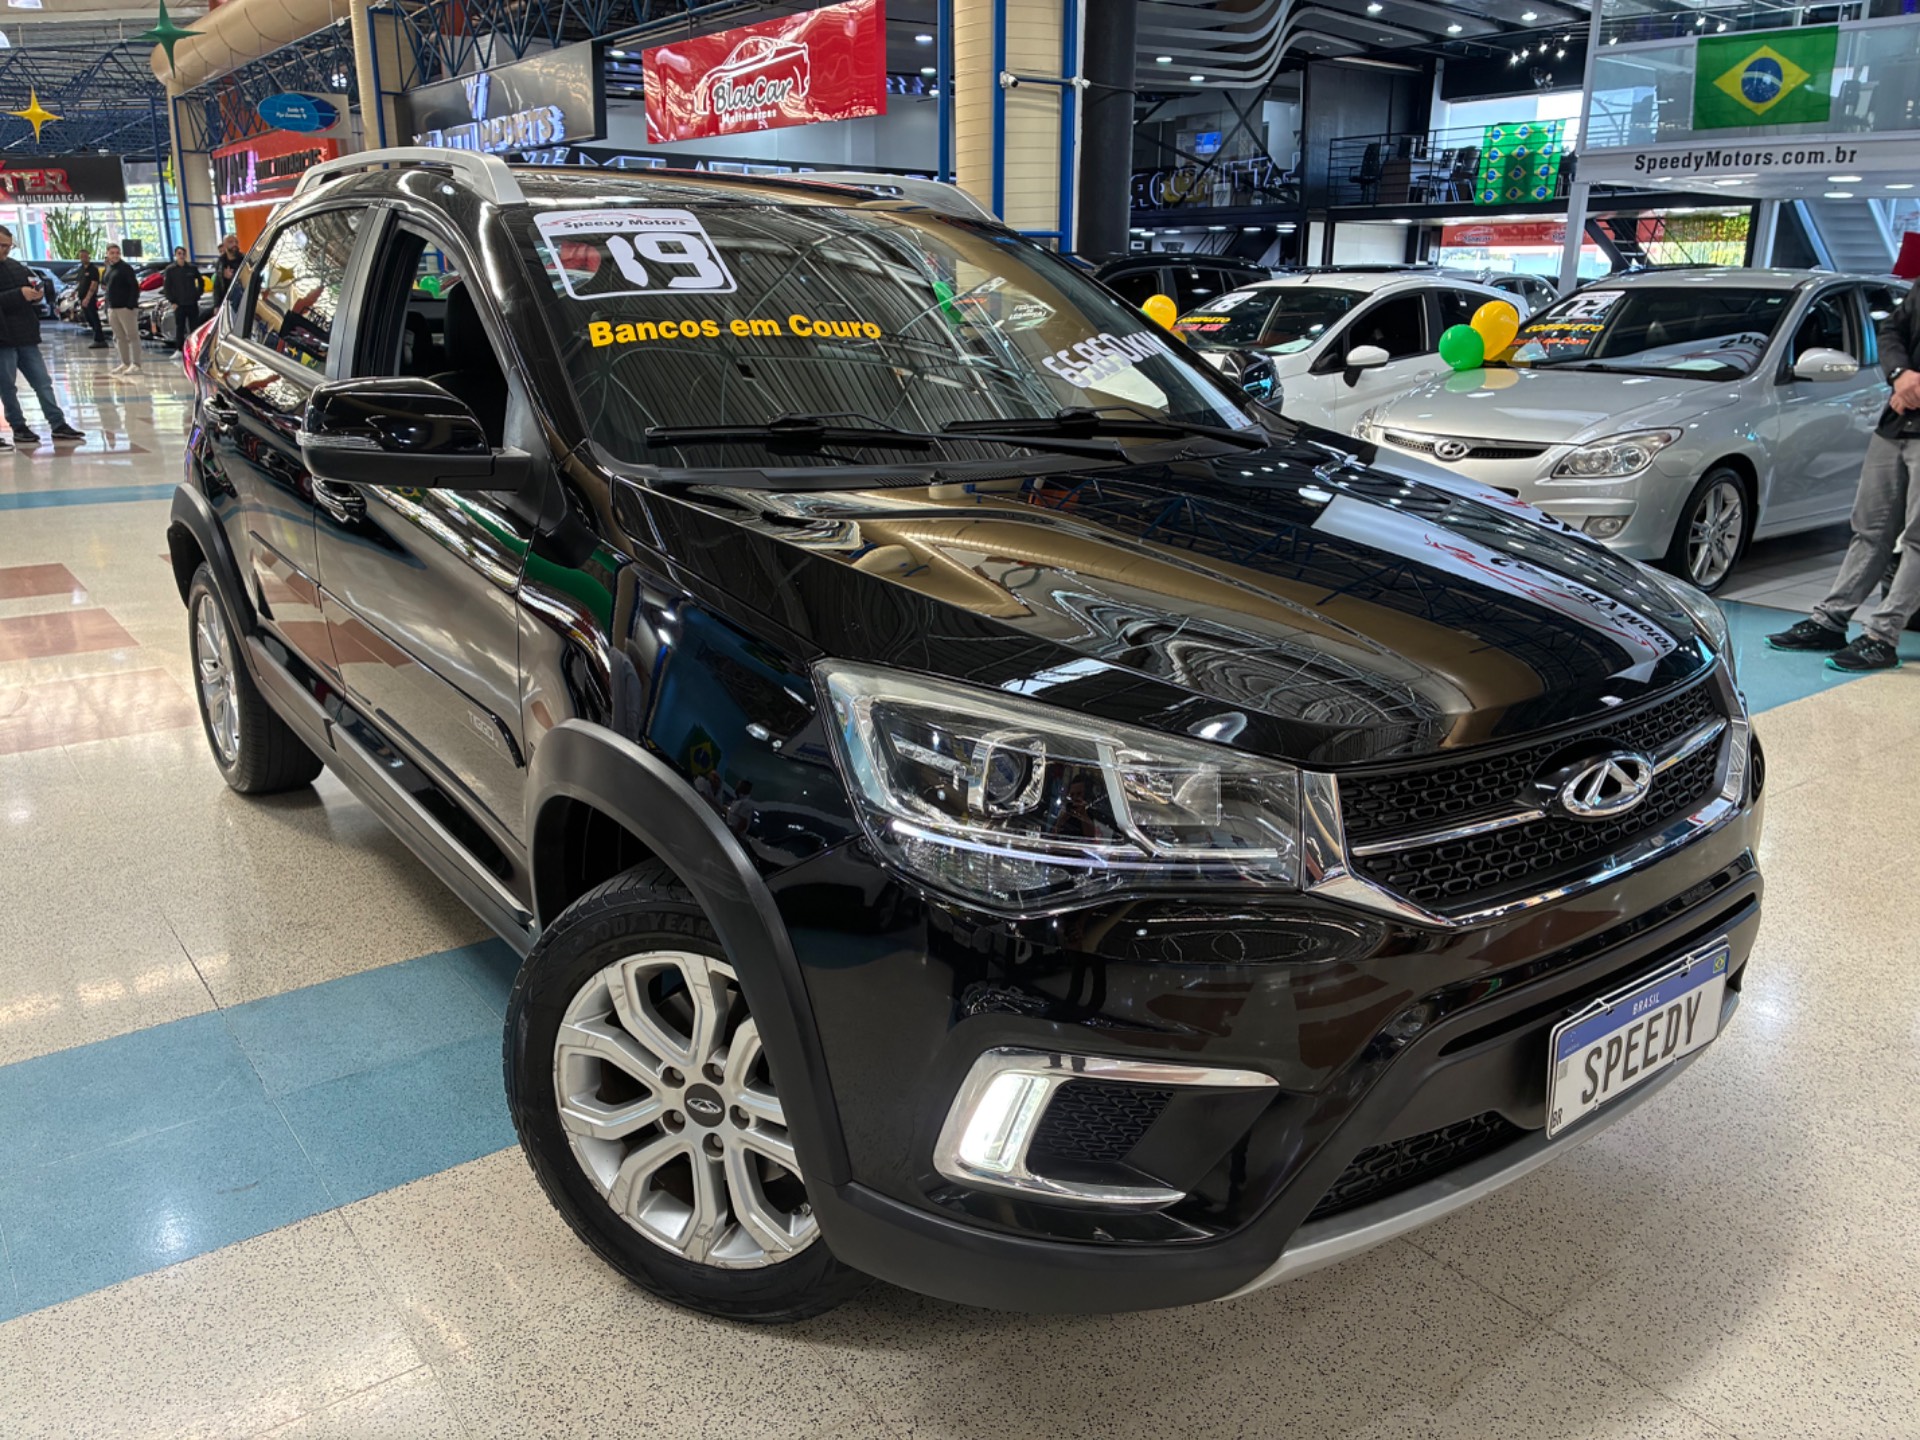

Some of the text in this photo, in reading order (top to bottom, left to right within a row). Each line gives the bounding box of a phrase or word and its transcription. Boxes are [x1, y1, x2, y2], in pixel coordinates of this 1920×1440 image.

[712, 76, 793, 114] BlasCar
[1634, 147, 1858, 174] SpeedyMotors.com.br
[17, 193, 86, 203] MULTIMARCAS
[605, 232, 725, 289] 19
[588, 314, 882, 348] Bancos em Couro
[1632, 991, 1660, 1016] BRASIL
[1582, 991, 1702, 1105] SPEEDY
